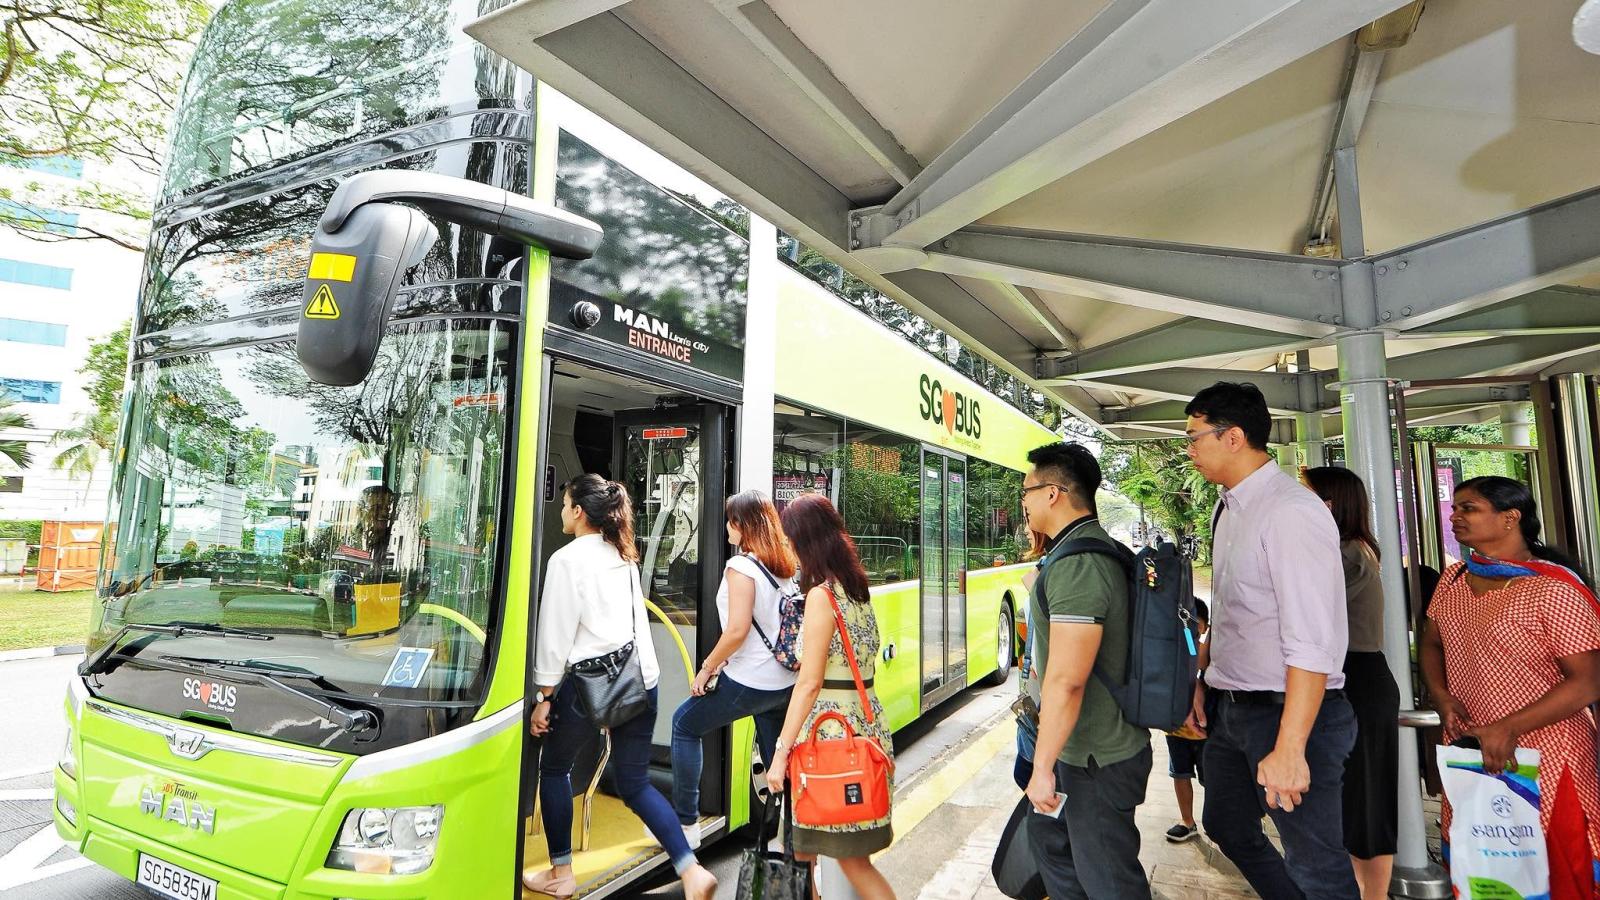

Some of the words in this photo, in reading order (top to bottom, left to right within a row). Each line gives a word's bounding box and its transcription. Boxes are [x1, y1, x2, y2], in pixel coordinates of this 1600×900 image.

[613, 303, 669, 339] MAN
[692, 341, 710, 354] City
[628, 328, 691, 363] ENTRANCE
[955, 391, 981, 440] BUS
[209, 682, 237, 708] BUS
[173, 782, 198, 801] Transit
[141, 788, 217, 835] MAN
[1471, 825, 1534, 846] sangm
[143, 860, 211, 900] SG5835M
